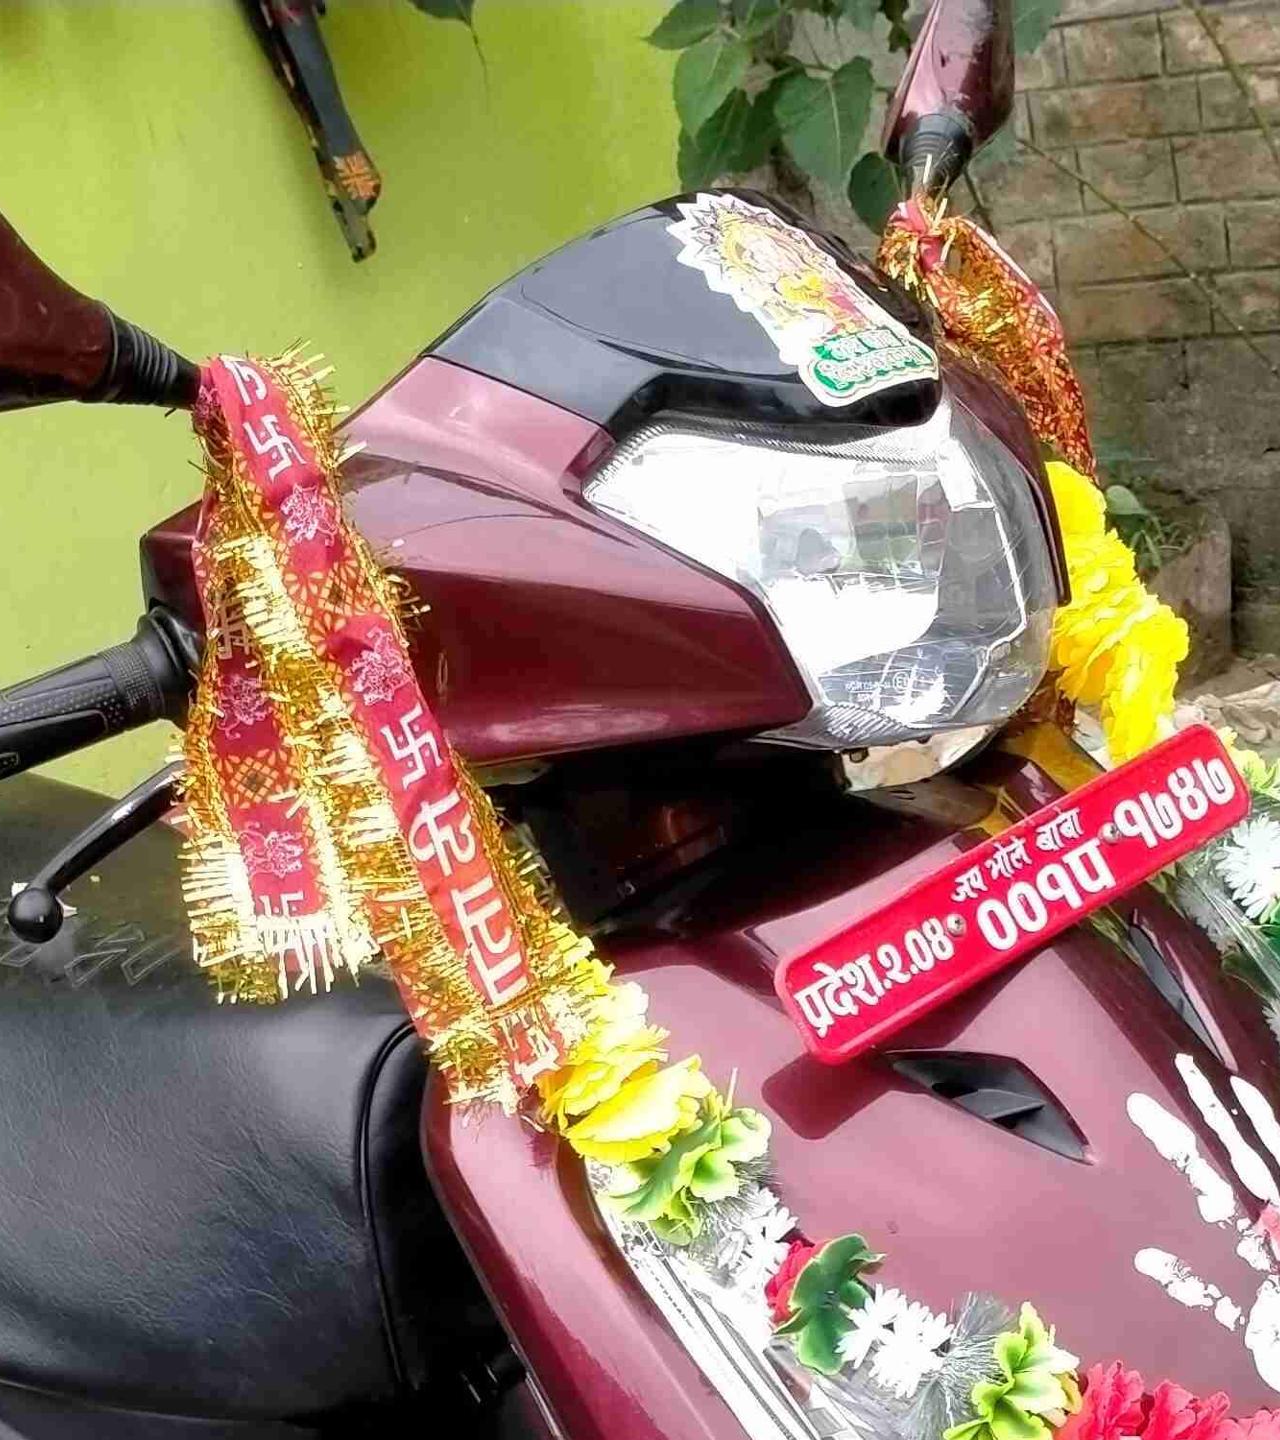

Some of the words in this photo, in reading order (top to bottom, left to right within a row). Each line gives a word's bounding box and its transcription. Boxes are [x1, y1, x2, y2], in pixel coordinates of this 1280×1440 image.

[408, 793, 478, 877] दी
[1112, 757, 1236, 848] १७४७
[951, 868, 988, 904] जय
[985, 836, 1032, 881] भोले
[1035, 807, 1084, 853] बाबा
